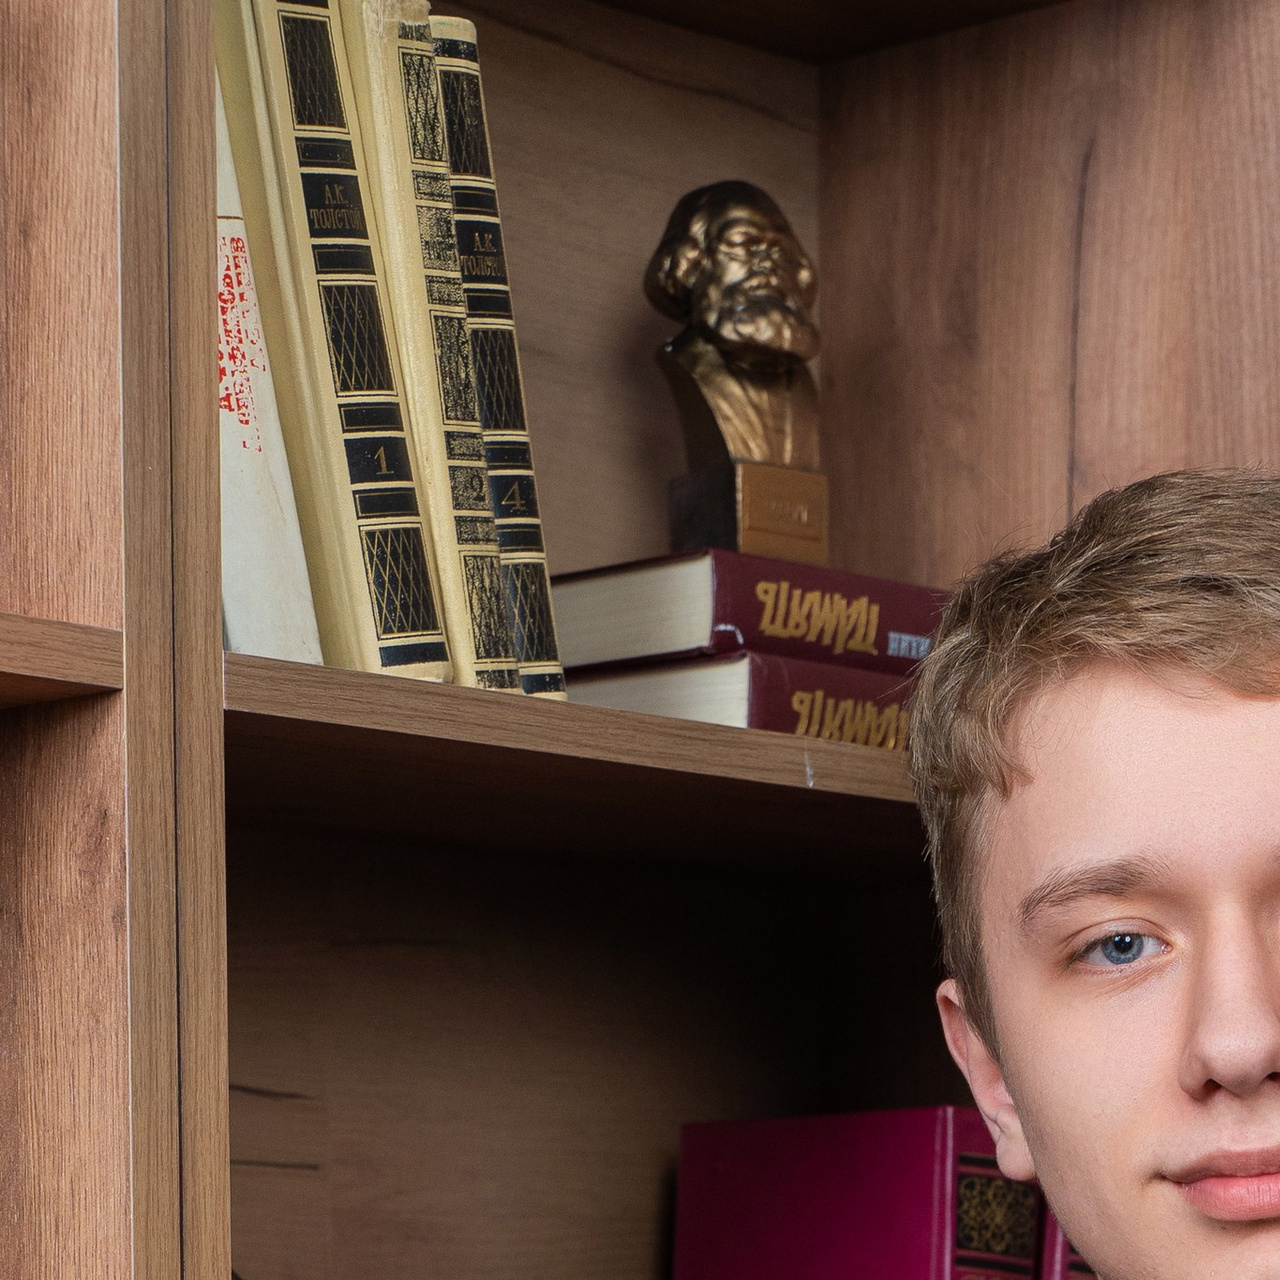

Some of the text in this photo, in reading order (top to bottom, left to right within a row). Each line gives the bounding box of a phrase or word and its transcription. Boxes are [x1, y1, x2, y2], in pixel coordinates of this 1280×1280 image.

[310, 206, 364, 230] ТОЛСТОЙ
[374, 446, 394, 474] 1
[501, 481, 527, 510] 4
